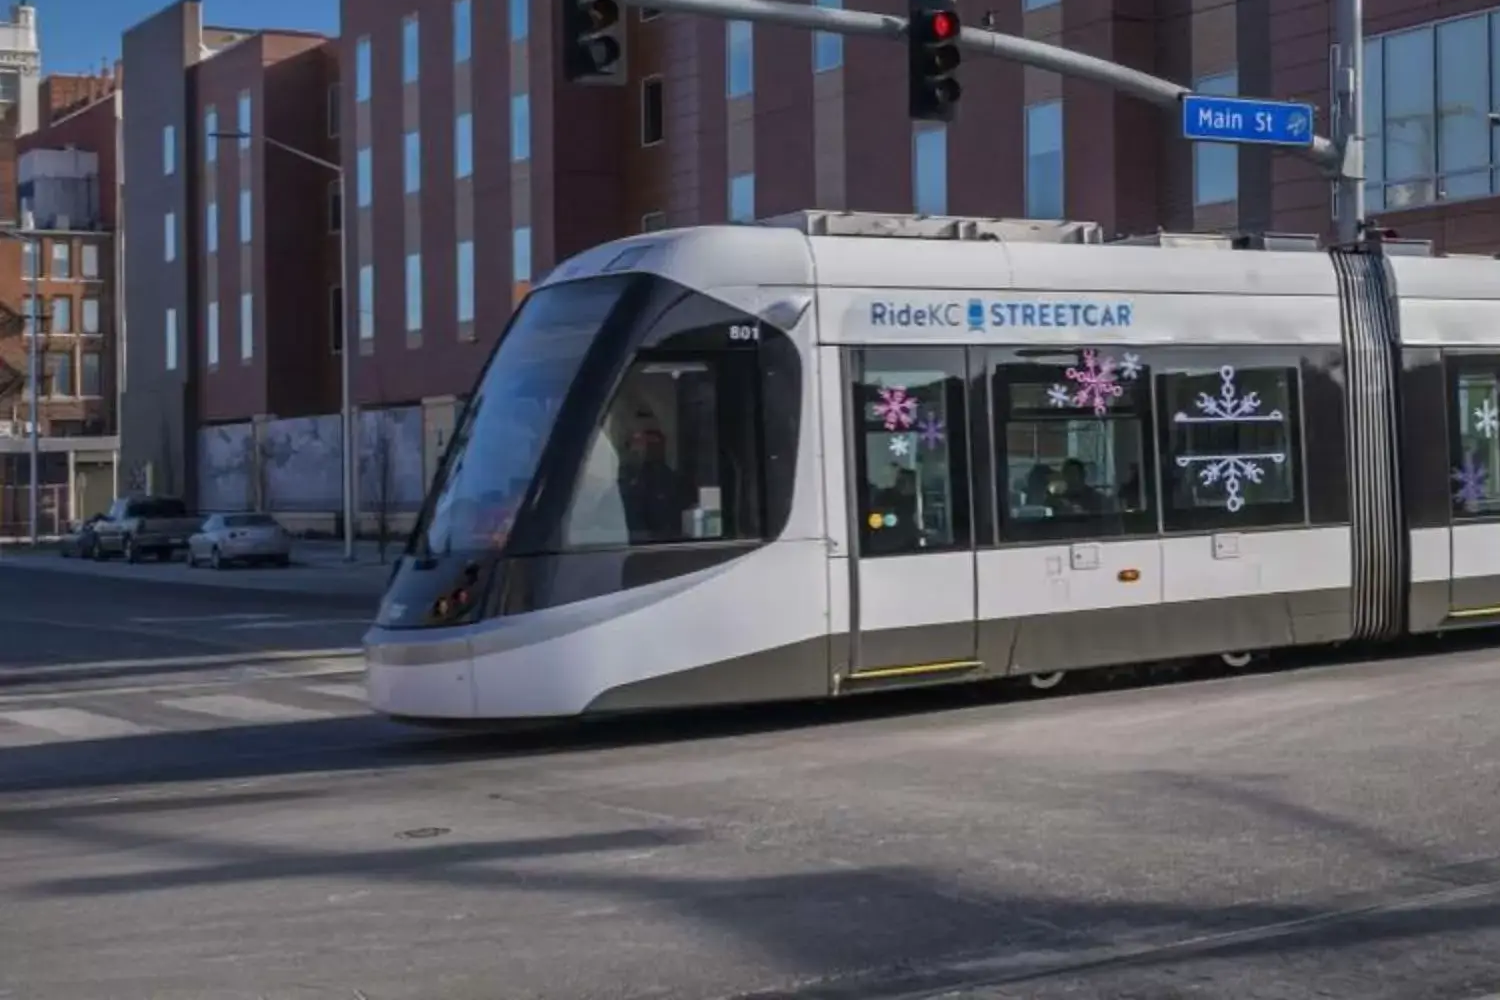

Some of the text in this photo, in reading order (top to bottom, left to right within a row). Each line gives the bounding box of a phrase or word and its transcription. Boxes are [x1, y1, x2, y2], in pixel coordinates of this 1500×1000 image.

[1198, 107, 1273, 133] Main St
[870, 302, 1133, 327] RideKC STREETCAR
[729, 325, 760, 340] 801
